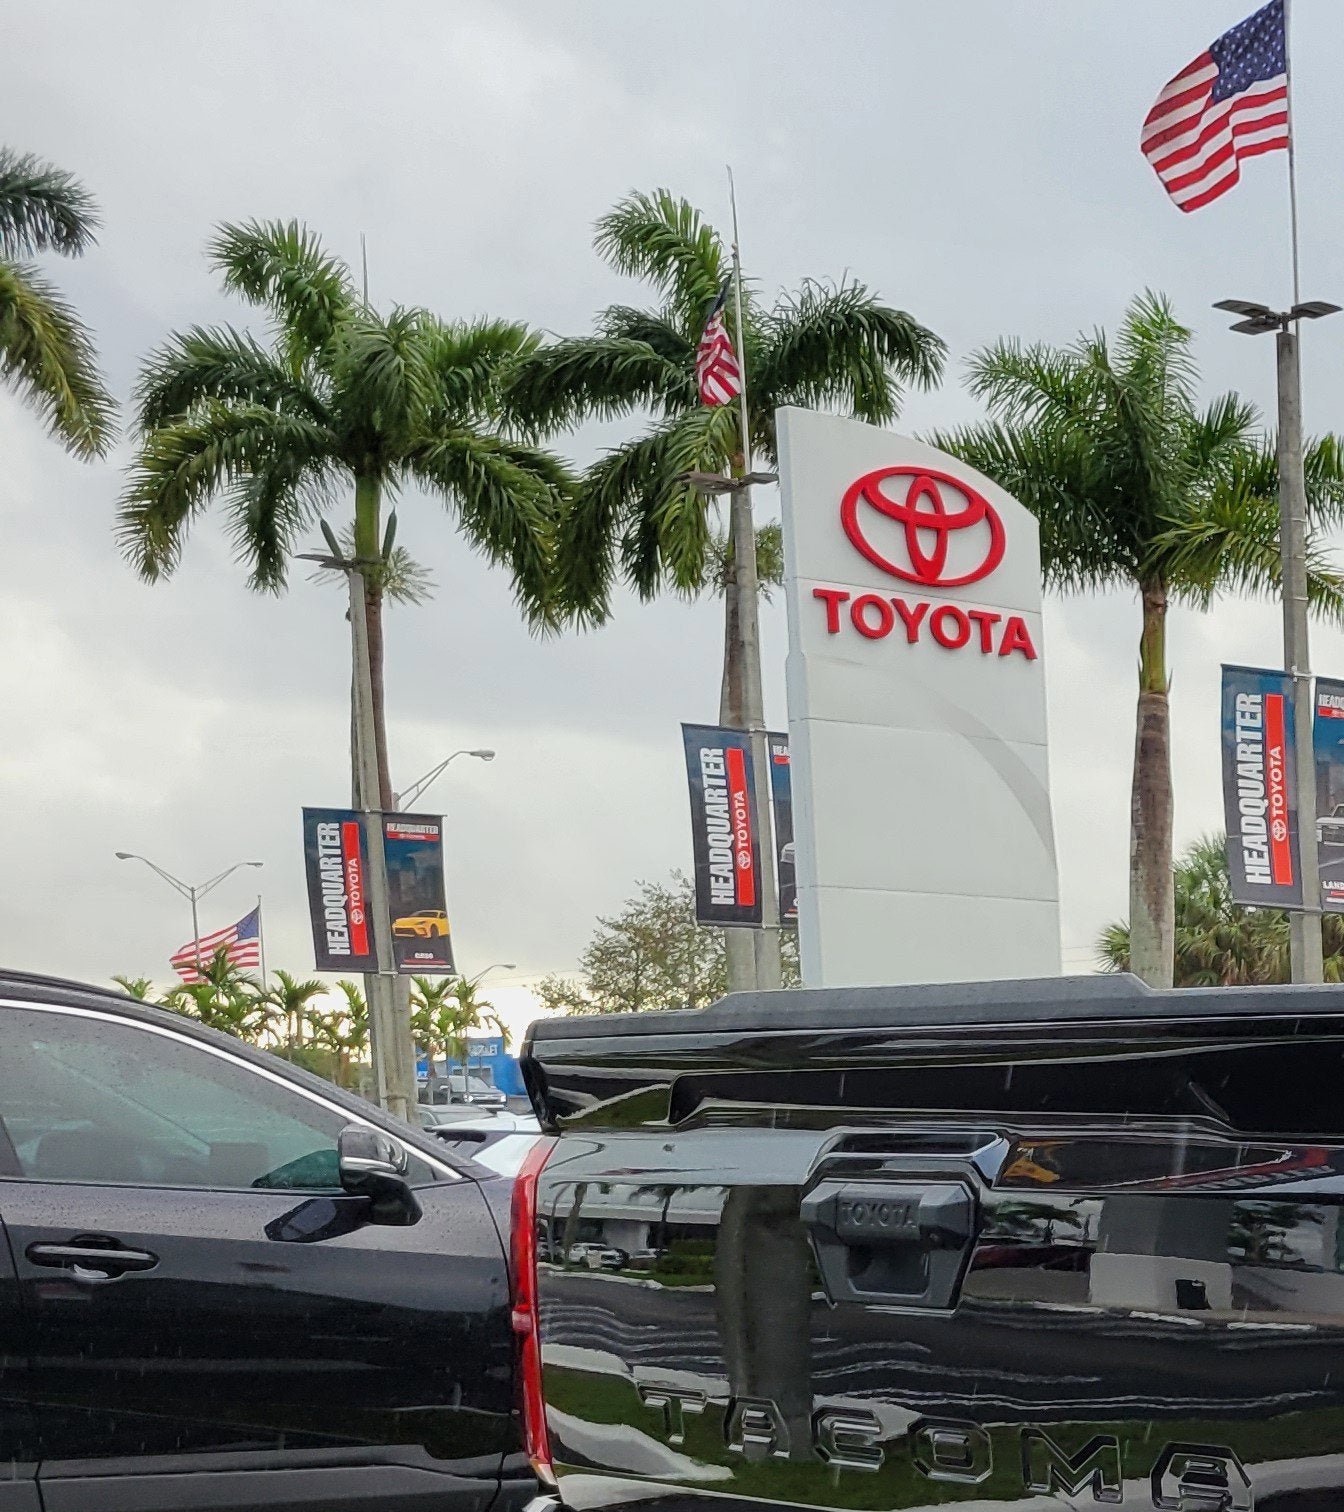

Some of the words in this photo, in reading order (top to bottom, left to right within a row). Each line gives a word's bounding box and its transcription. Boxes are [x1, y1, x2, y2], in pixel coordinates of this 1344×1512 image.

[812, 588, 1039, 660] TOYOTA
[1235, 693, 1272, 885] HEADQUARTER
[1269, 746, 1284, 818] TOYOTA
[699, 746, 735, 906] HEADQUARTER
[734, 790, 749, 851] TOYOTA
[317, 821, 352, 957] HEADQUARTER
[348, 858, 362, 908] TOYOTA
[841, 1202, 918, 1228] TOYOTA
